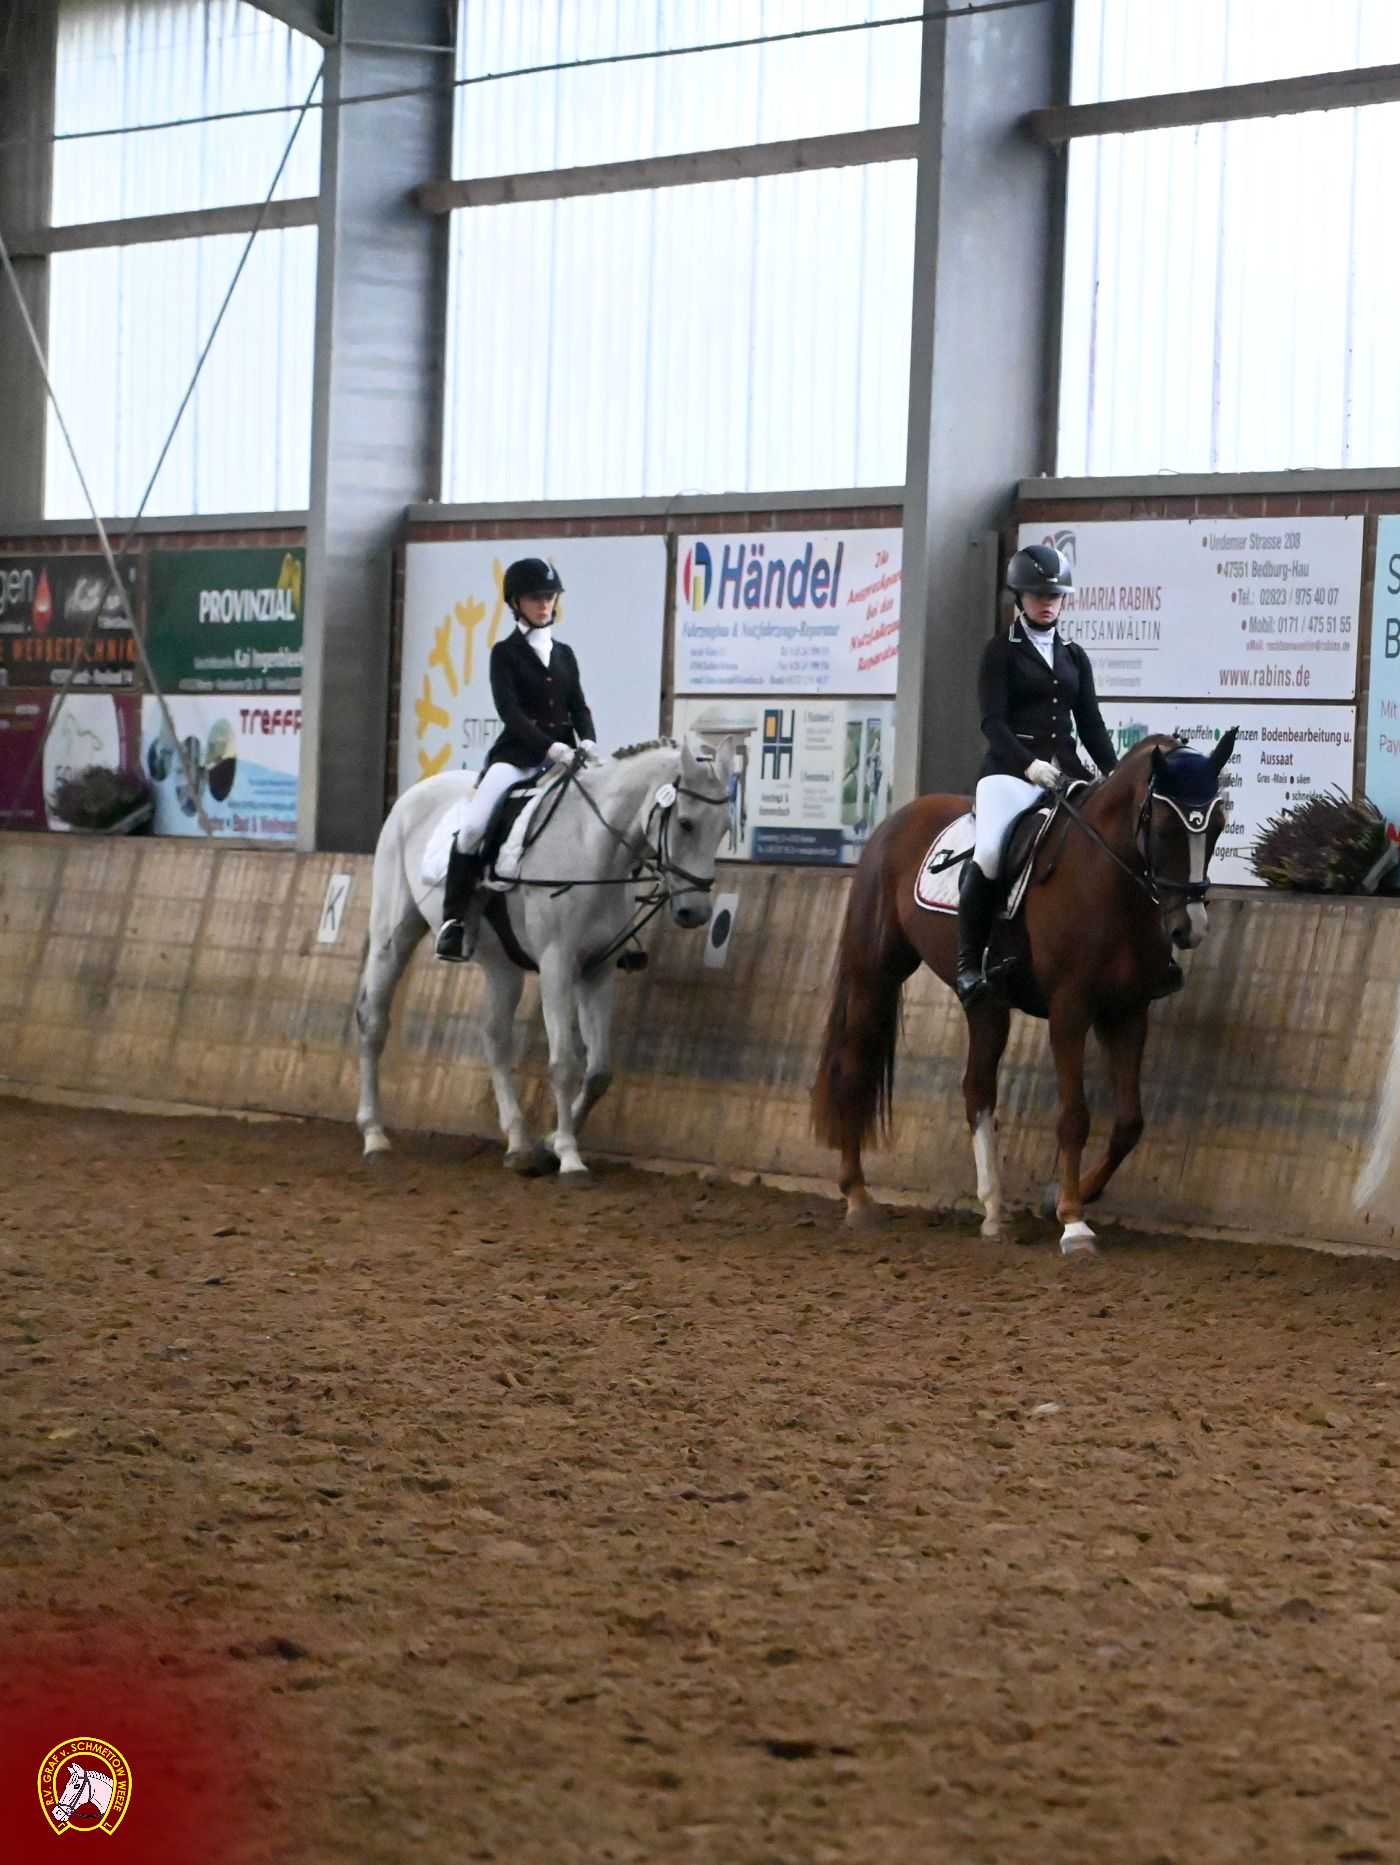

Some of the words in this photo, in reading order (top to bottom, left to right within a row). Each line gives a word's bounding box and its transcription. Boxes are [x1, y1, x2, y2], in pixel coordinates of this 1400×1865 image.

[1250, 533, 1283, 550] Strasse
[717, 541, 845, 610] Händel
[1251, 560, 1310, 581] Bedburg-Hau
[199, 588, 296, 623] PROVINZIAL
[1119, 584, 1163, 611] RABINS
[1061, 617, 1161, 641] ECHTSANWÄLTIN
[1277, 616, 1300, 633] 0171
[1219, 664, 1311, 687] www.rabins.de
[1381, 701, 1398, 719] Mit
[1261, 727, 1342, 746] Bodenbearbeitung
[1343, 731, 1352, 742] u.
[1260, 751, 1294, 766] Aussaat
